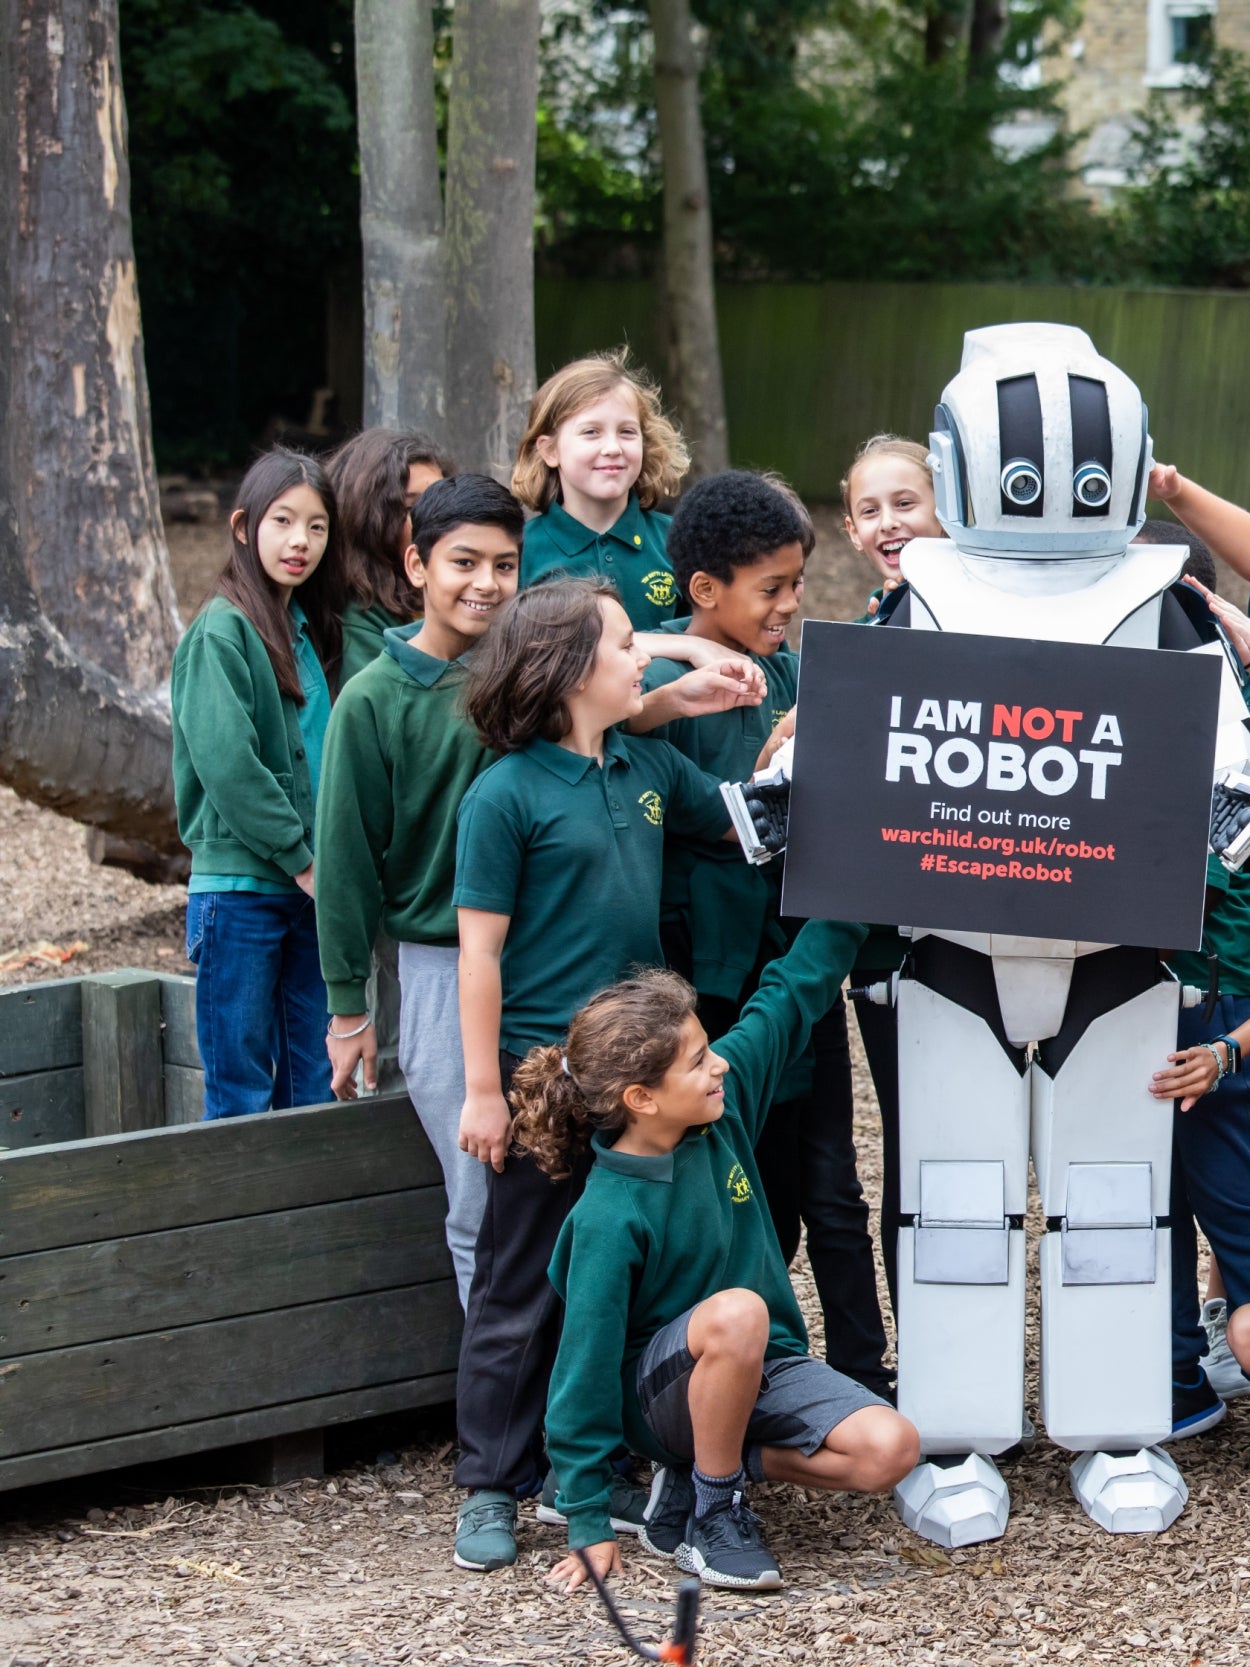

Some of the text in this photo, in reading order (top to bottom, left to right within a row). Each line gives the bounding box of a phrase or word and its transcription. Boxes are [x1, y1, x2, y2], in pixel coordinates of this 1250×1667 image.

[889, 695, 1124, 747] I AM NOT A
[884, 731, 1123, 800] ROBOT
[930, 801, 1071, 831] Find out more
[881, 827, 1116, 861] warchild.org.uk/robot
[920, 853, 1073, 883] #EscapeRobot
